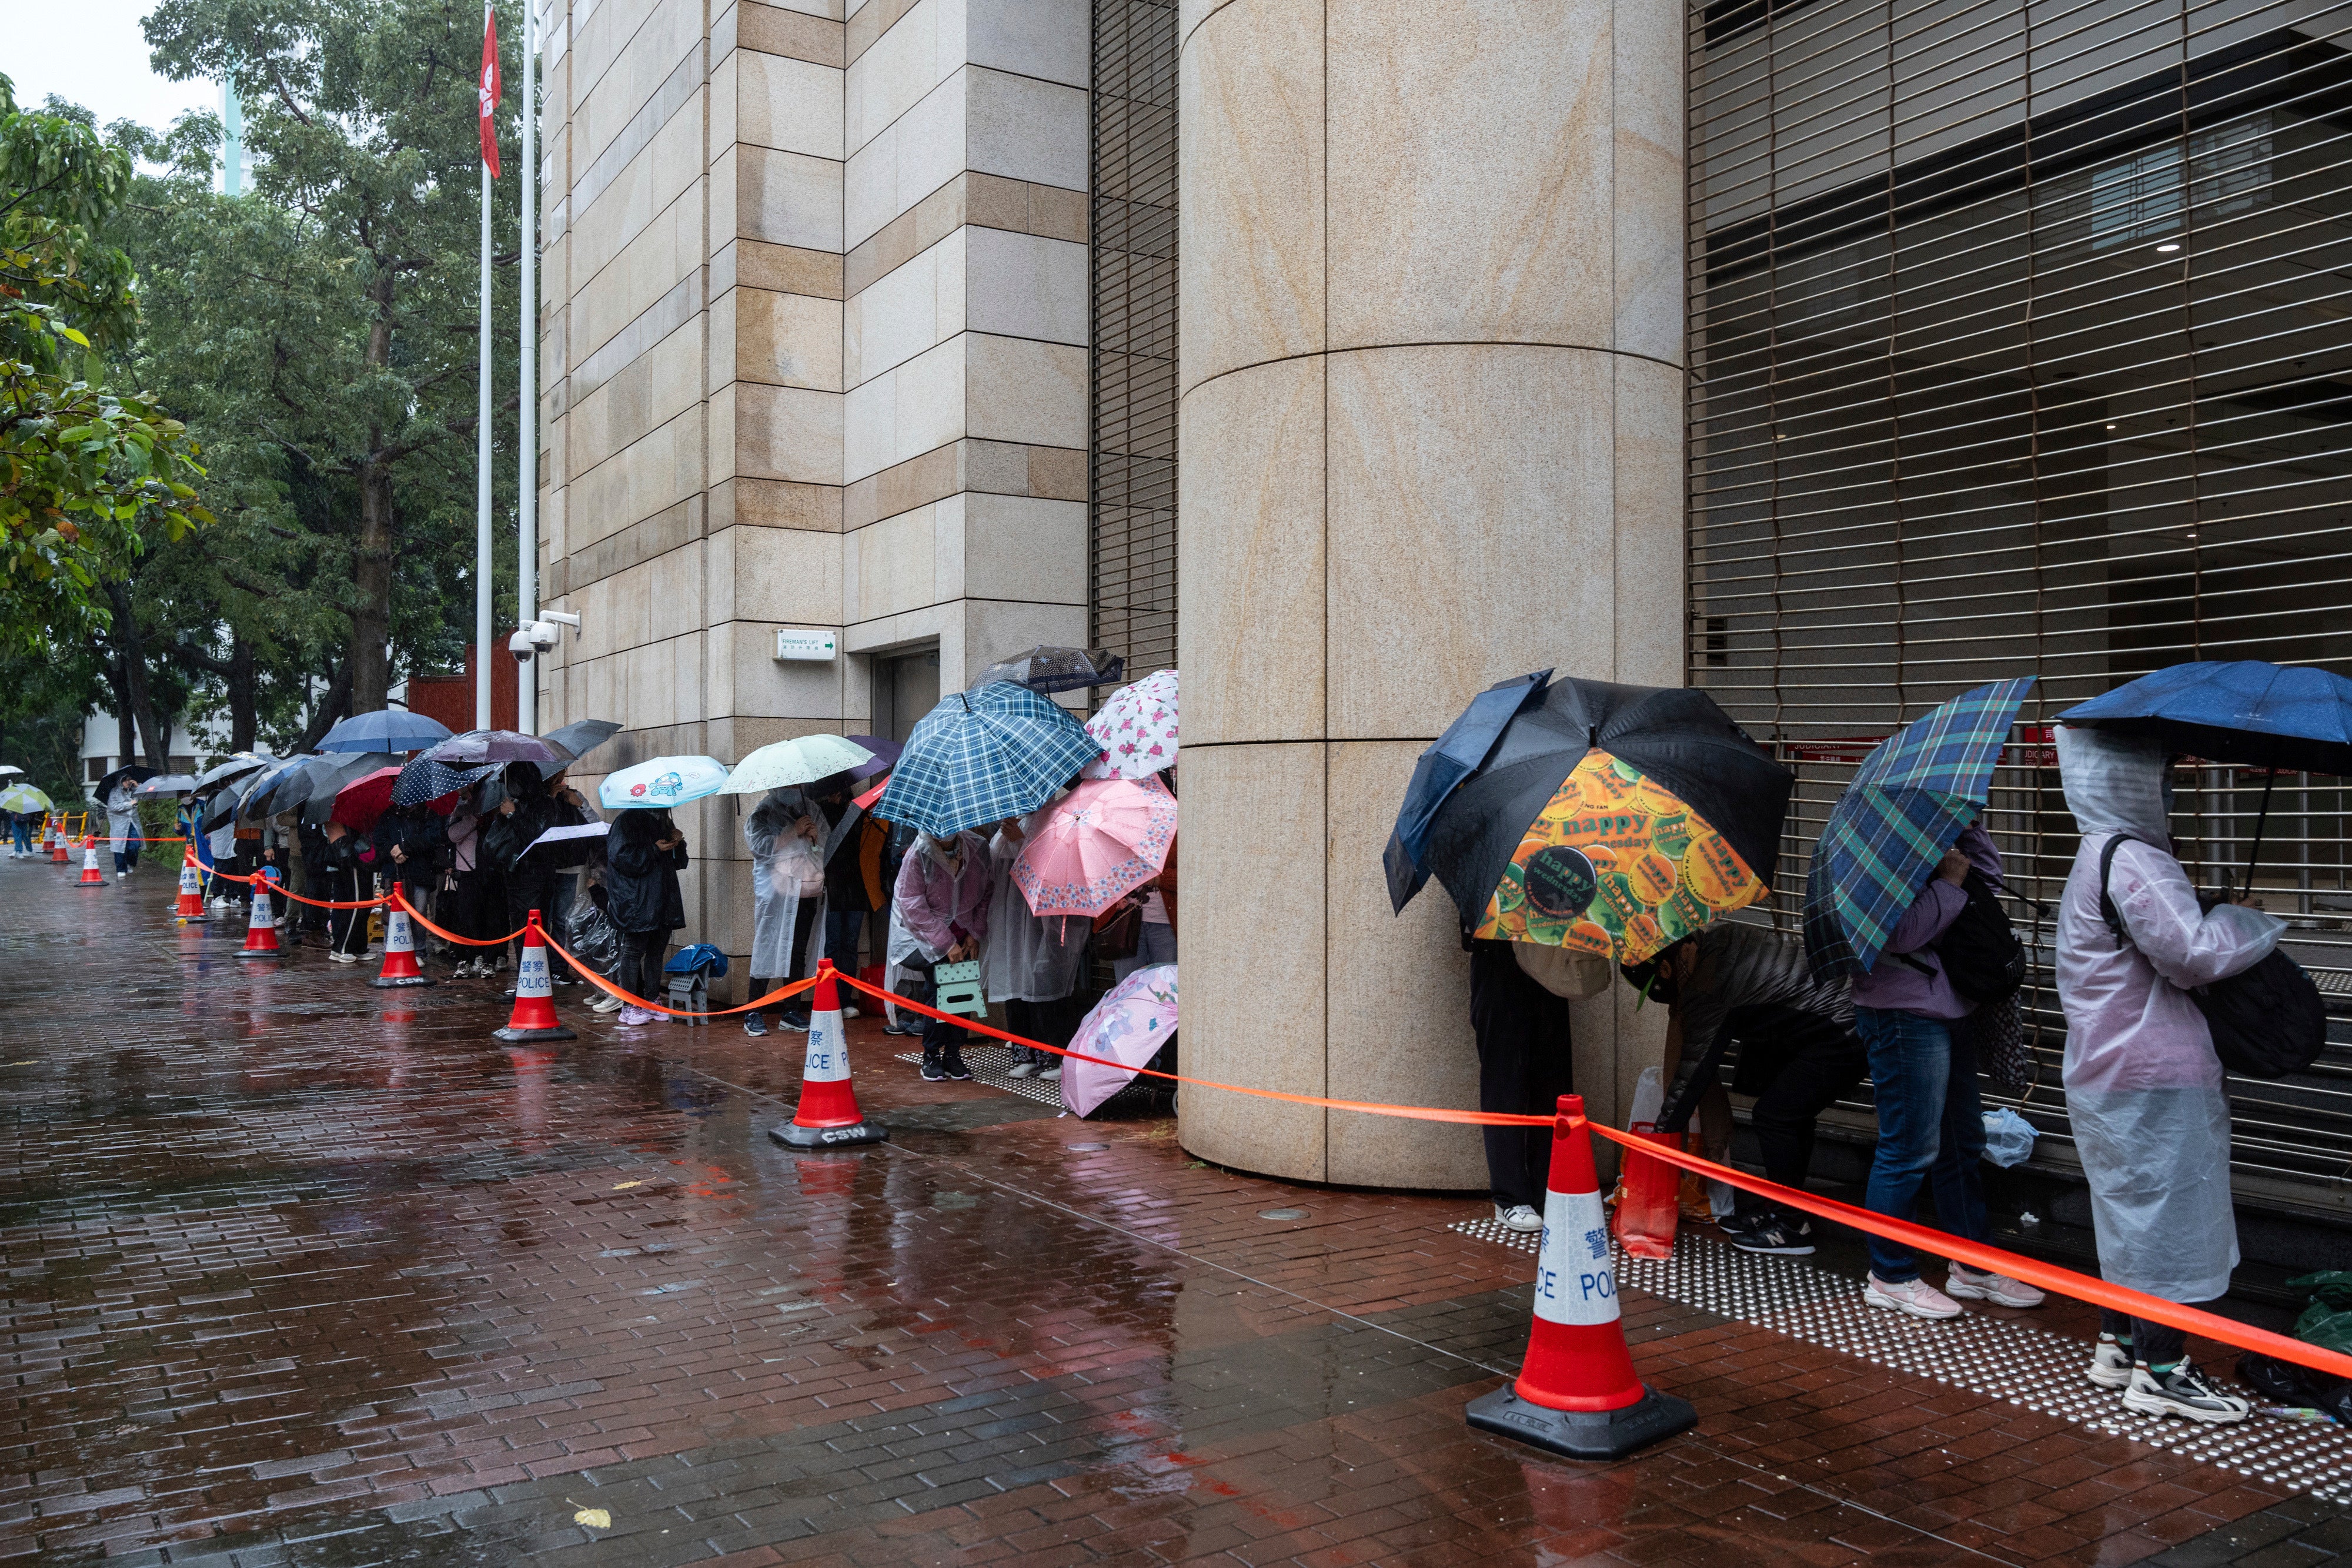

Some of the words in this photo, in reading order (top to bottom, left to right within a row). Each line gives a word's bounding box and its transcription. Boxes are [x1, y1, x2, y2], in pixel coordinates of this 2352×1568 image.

[1563, 815, 1648, 836] happy
[1654, 822, 1686, 835] happ
[1698, 842, 1735, 897] wednesday
[1708, 832, 1748, 887] happy
[1540, 851, 1593, 892] happy
[1642, 854, 1675, 891] happy
[1534, 867, 1584, 903] wednesday
[1685, 871, 1695, 888] HAPPY
[1692, 888, 1710, 903] RACING
[1675, 885, 1706, 928] happy
[1530, 919, 1572, 928] wednesday
[1568, 928, 1611, 951] happy
[522, 960, 544, 972] 警察
[518, 977, 550, 988] POLICE
[821, 1126, 866, 1144] CSW
[1765, 1231, 1786, 1247] N
